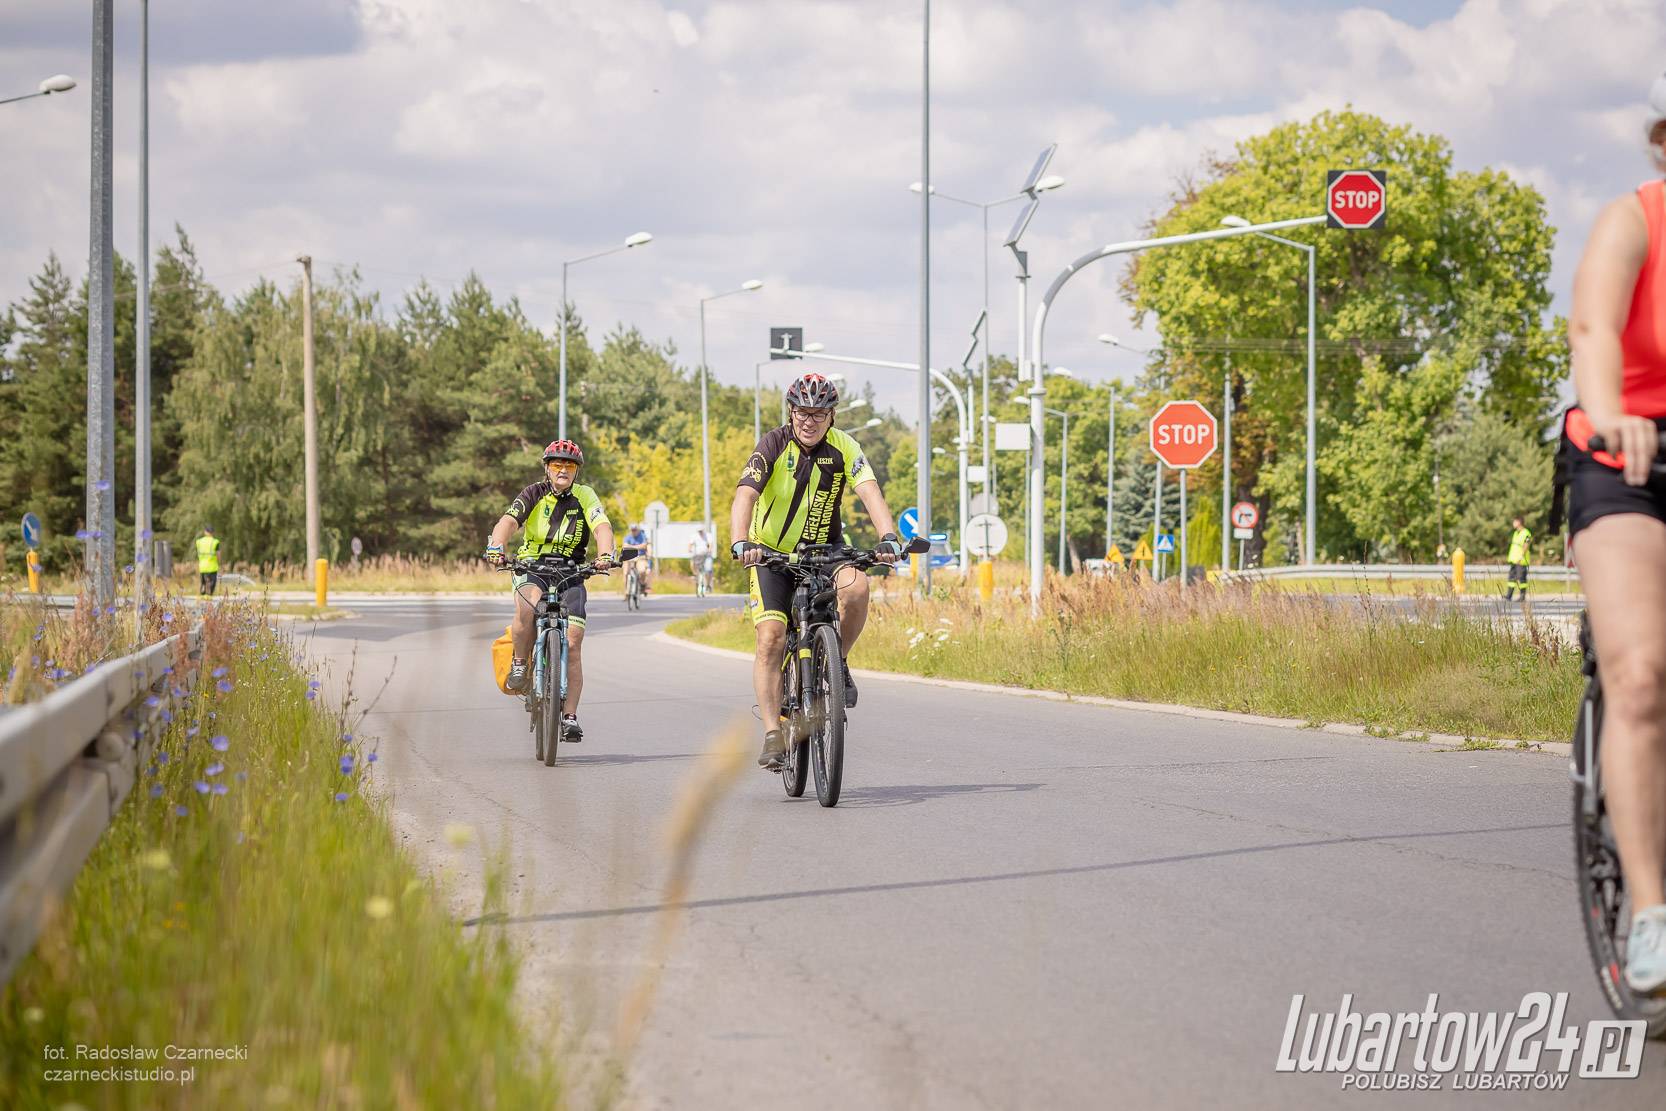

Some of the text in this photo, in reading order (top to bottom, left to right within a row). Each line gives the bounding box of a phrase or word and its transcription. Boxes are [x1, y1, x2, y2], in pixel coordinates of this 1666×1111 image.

[1334, 190, 1380, 209] STOP
[1158, 424, 1210, 445] STOP
[820, 472, 844, 526] ROWEROWA
